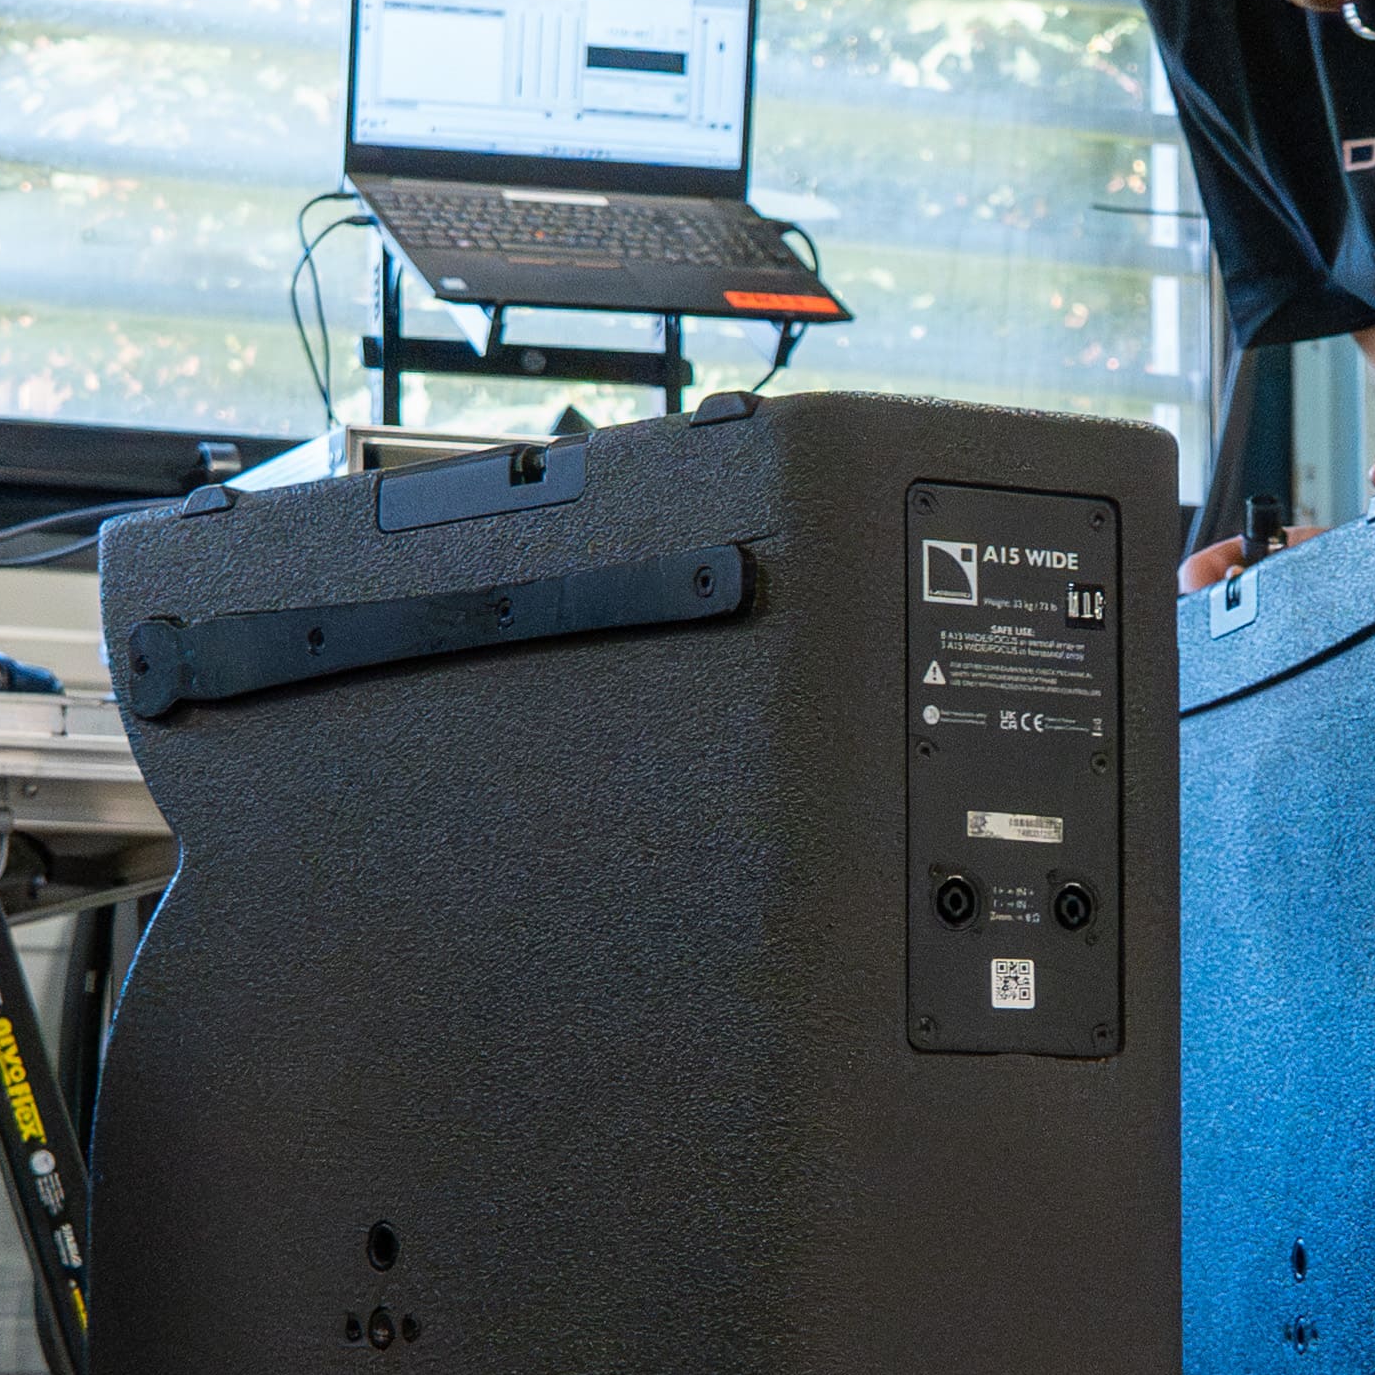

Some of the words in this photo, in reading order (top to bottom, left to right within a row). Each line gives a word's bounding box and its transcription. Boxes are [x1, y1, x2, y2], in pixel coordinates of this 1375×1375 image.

[982, 545, 1021, 565] A15
[1024, 548, 1079, 570] WIDE
[999, 710, 1017, 720] UK
[999, 720, 1018, 730] CA
